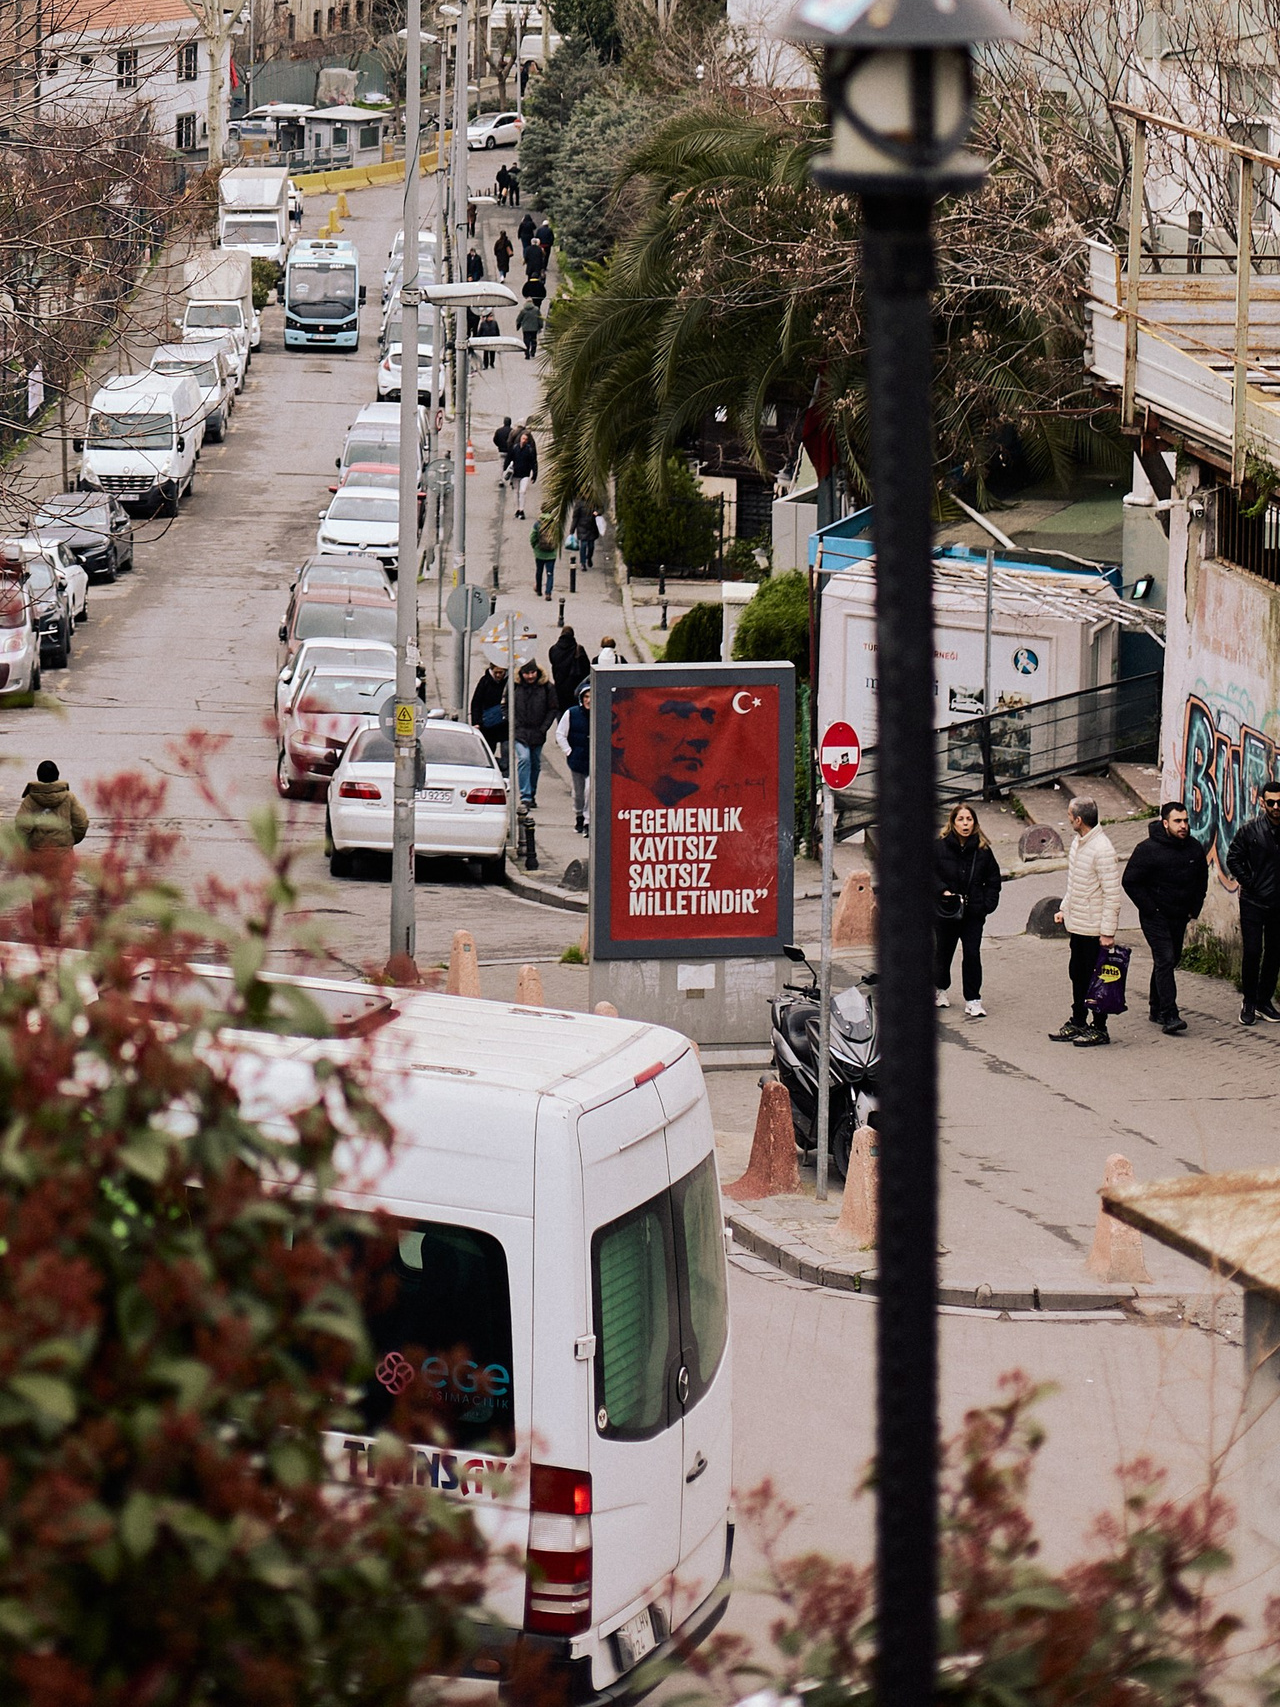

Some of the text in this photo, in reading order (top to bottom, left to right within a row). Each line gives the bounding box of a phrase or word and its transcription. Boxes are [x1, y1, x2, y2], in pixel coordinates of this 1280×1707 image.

[863, 642, 958, 661] TÜR RNEĞİ
[629, 836, 718, 862] KAYITSIZ
[628, 863, 712, 892] ŞARTSIZ
[424, 1391, 509, 1410] AŞIMACILIK
